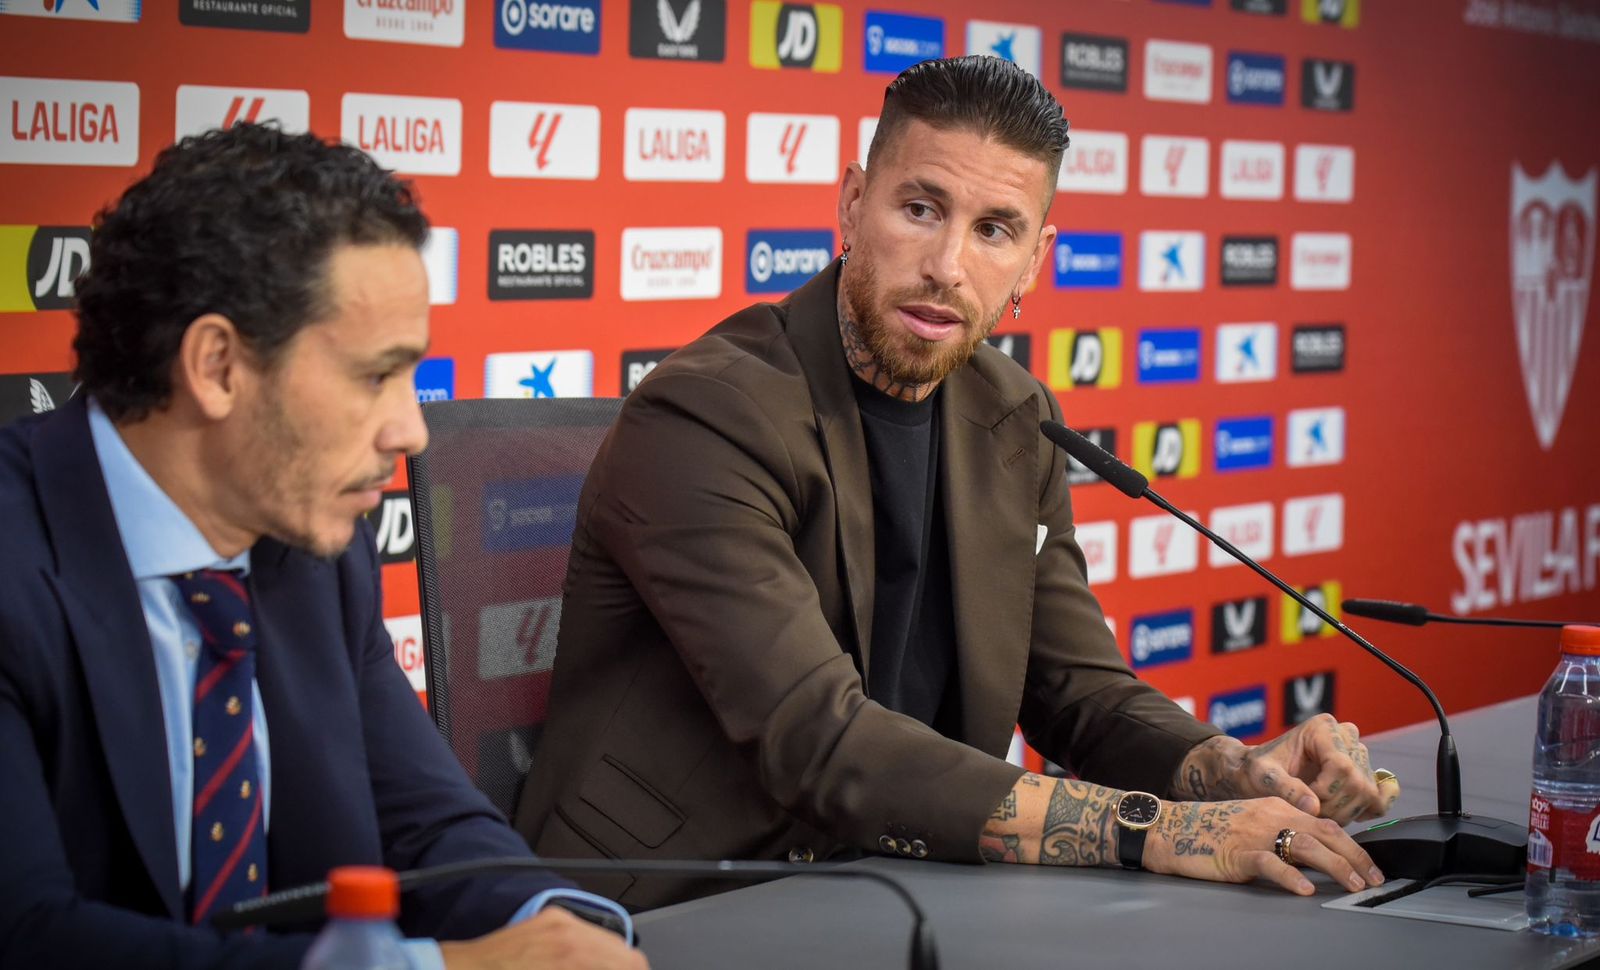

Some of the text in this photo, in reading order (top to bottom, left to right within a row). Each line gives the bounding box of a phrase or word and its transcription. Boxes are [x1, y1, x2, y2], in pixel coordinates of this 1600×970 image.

[529, 5, 594, 33] sorare
[778, 11, 816, 61] JD
[12, 99, 119, 144] LALIGA
[358, 114, 445, 154] LALIGA
[639, 127, 711, 162] LALIGA
[497, 243, 586, 273] ROBLES
[773, 248, 830, 274] sorare
[376, 498, 414, 555] JD
[1452, 508, 1580, 614] SEVILLA
